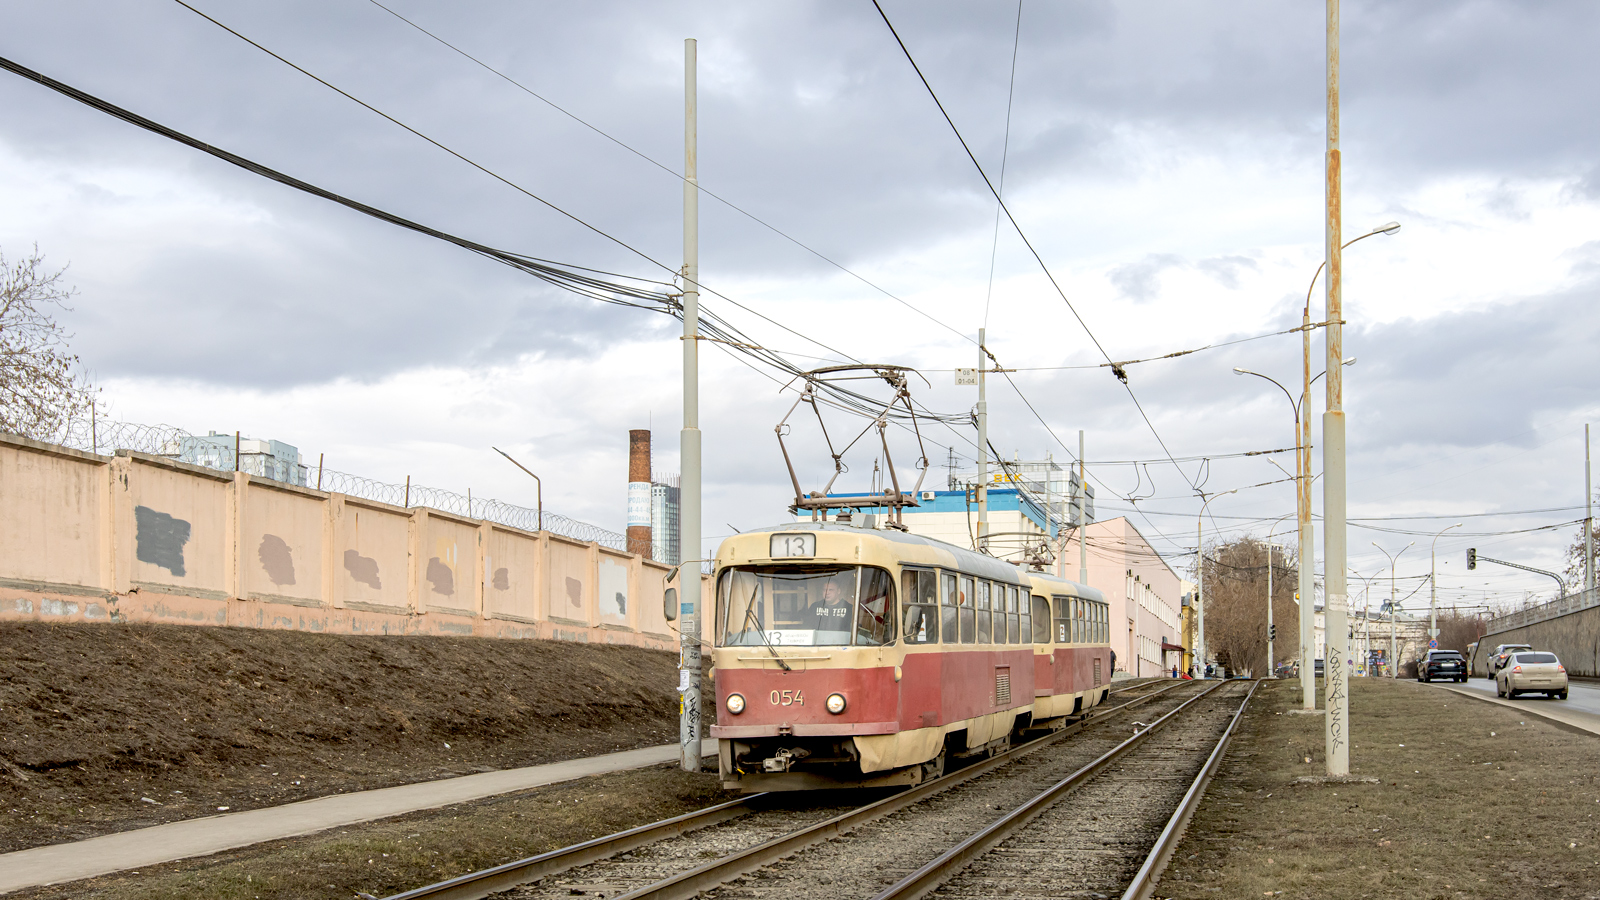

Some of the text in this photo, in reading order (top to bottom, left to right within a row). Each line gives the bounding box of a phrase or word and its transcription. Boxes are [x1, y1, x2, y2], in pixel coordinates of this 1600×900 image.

[784, 536, 805, 557] 13
[767, 631, 782, 646] 13
[770, 689, 804, 706] 054
